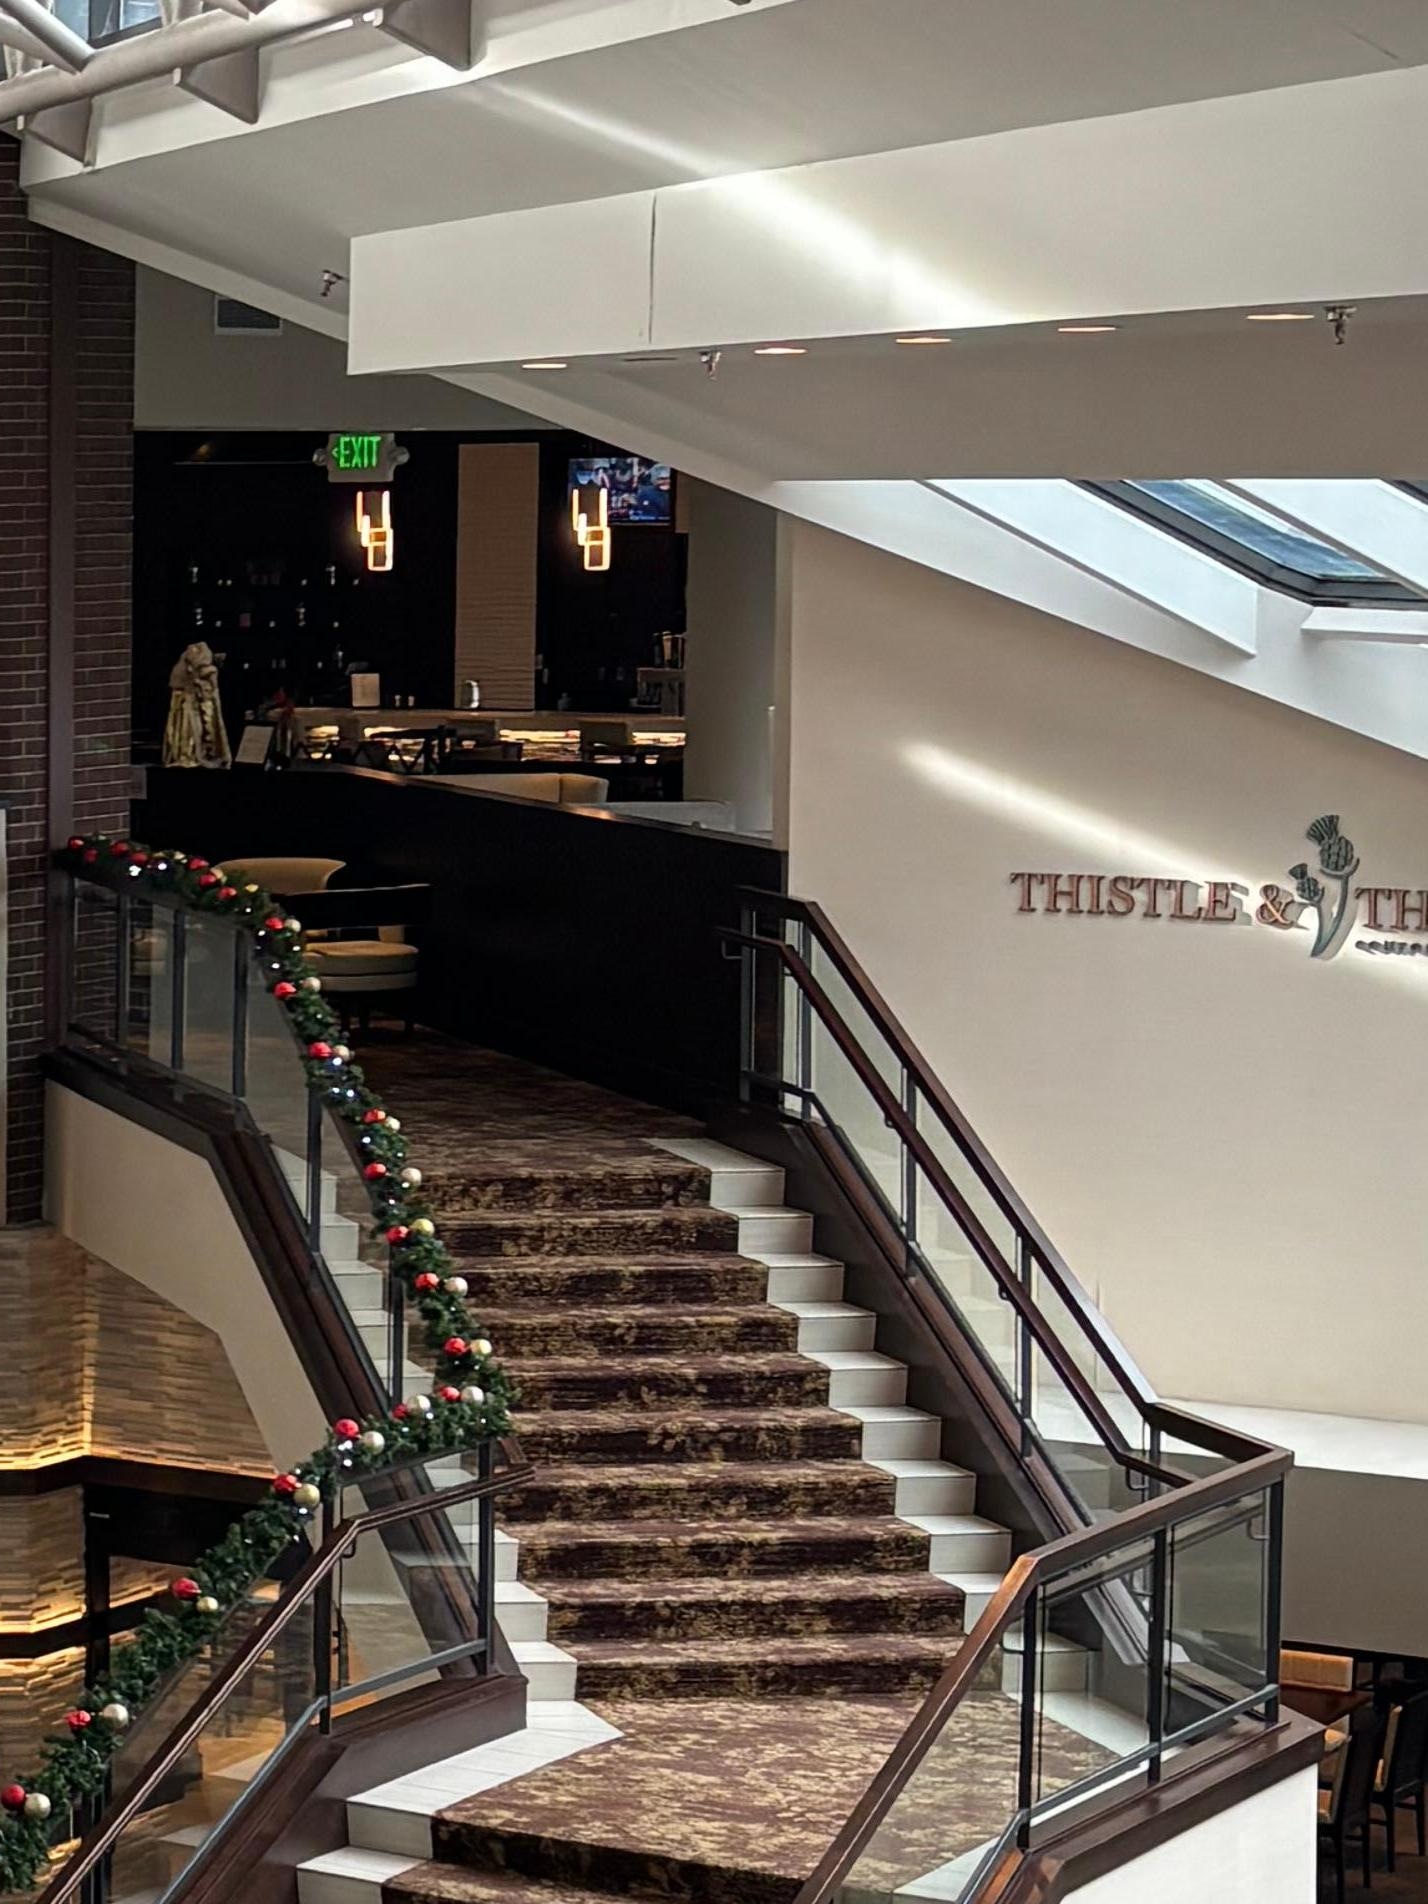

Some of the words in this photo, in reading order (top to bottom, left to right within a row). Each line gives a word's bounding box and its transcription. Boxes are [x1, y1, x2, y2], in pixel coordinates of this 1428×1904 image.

[339, 436, 382, 468] EXIT
[1010, 871, 1238, 924] THISTLE
[1256, 883, 1297, 930] &
